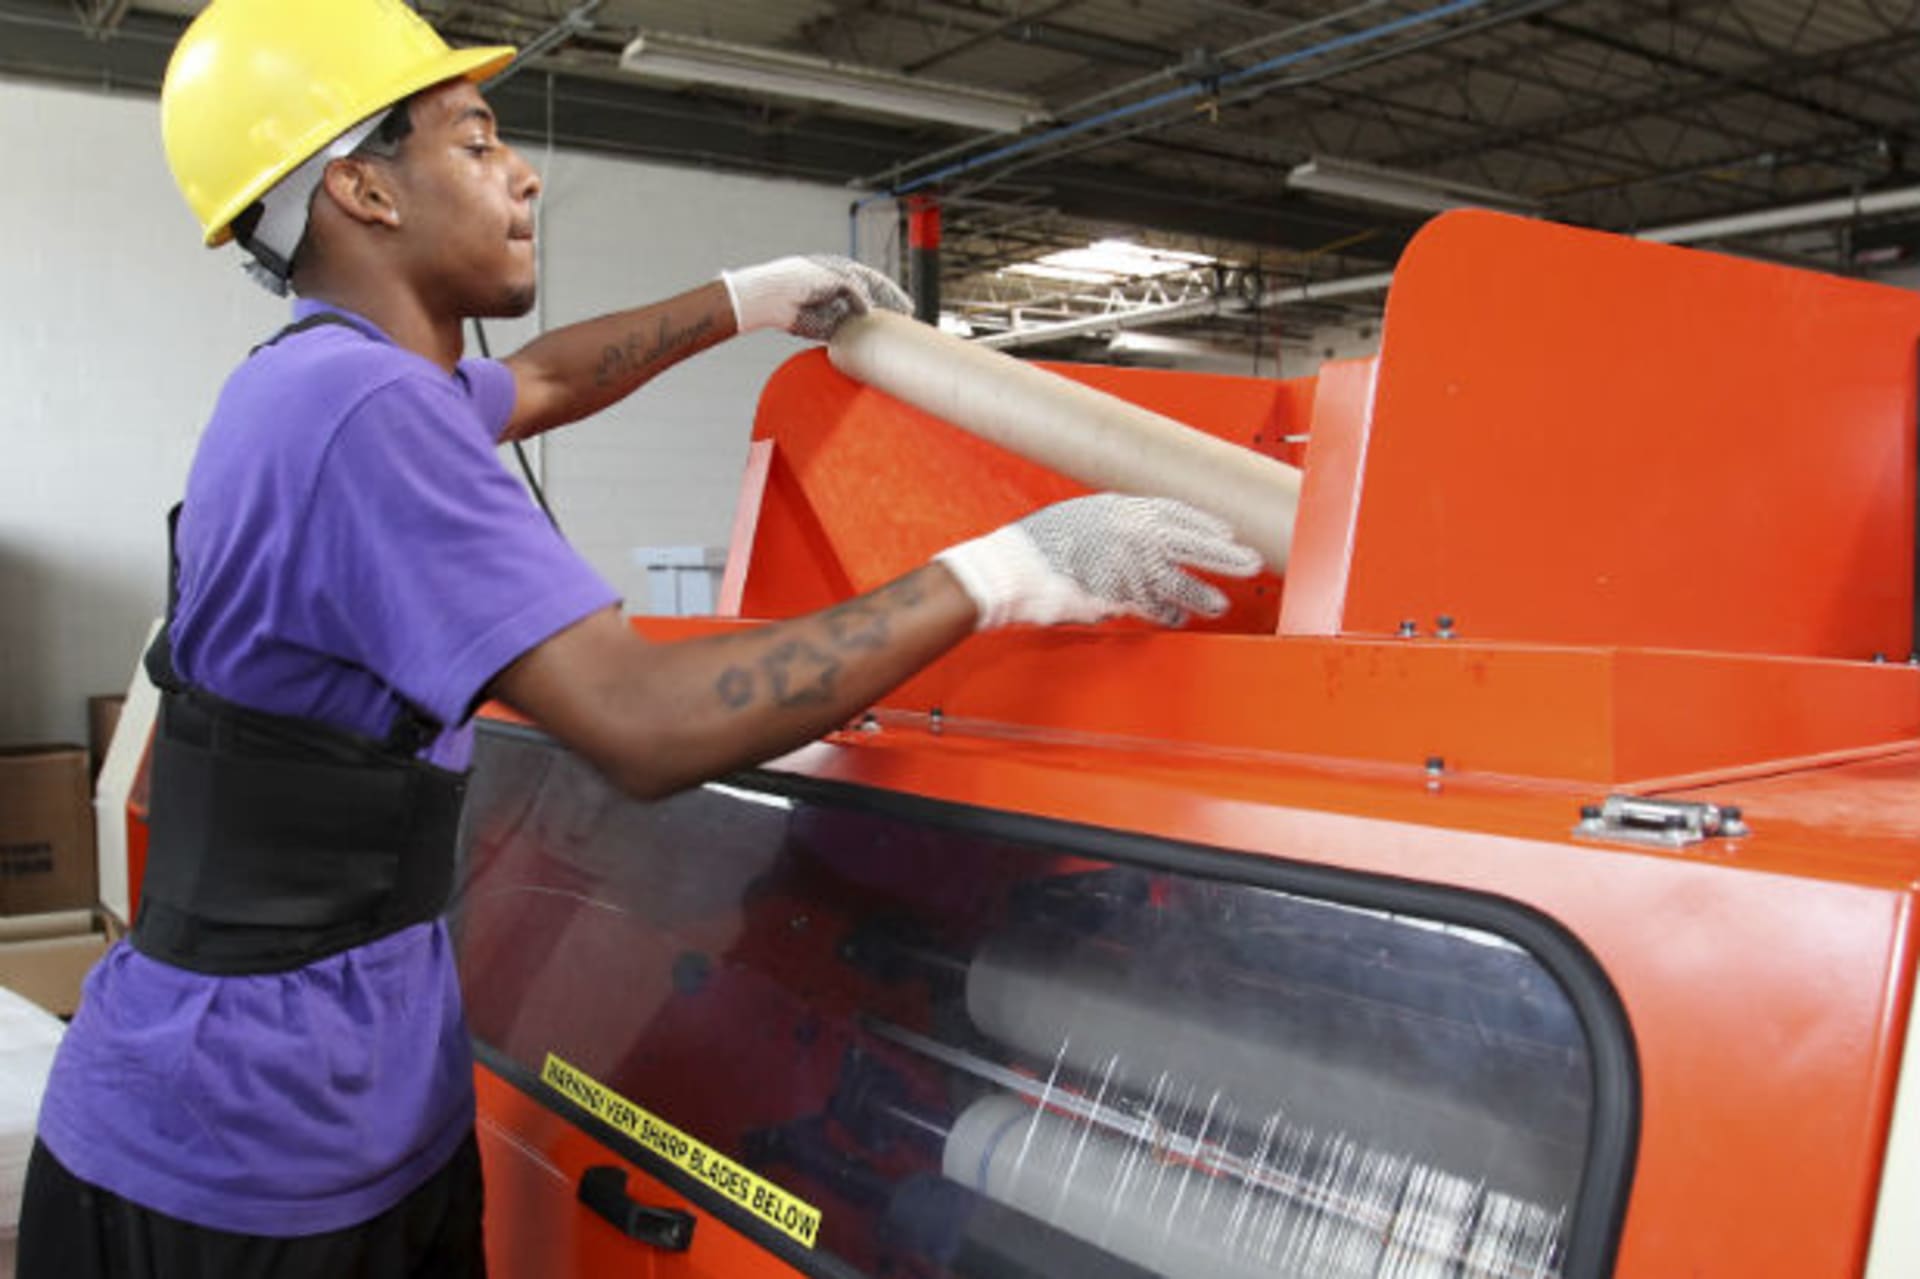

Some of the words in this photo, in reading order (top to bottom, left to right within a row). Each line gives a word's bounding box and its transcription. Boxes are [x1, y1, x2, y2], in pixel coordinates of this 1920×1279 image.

[605, 1100, 641, 1130] VERY
[641, 1119, 688, 1158] SHARP
[691, 1148, 751, 1200] BLADES
[752, 1186, 817, 1240] BELOW
